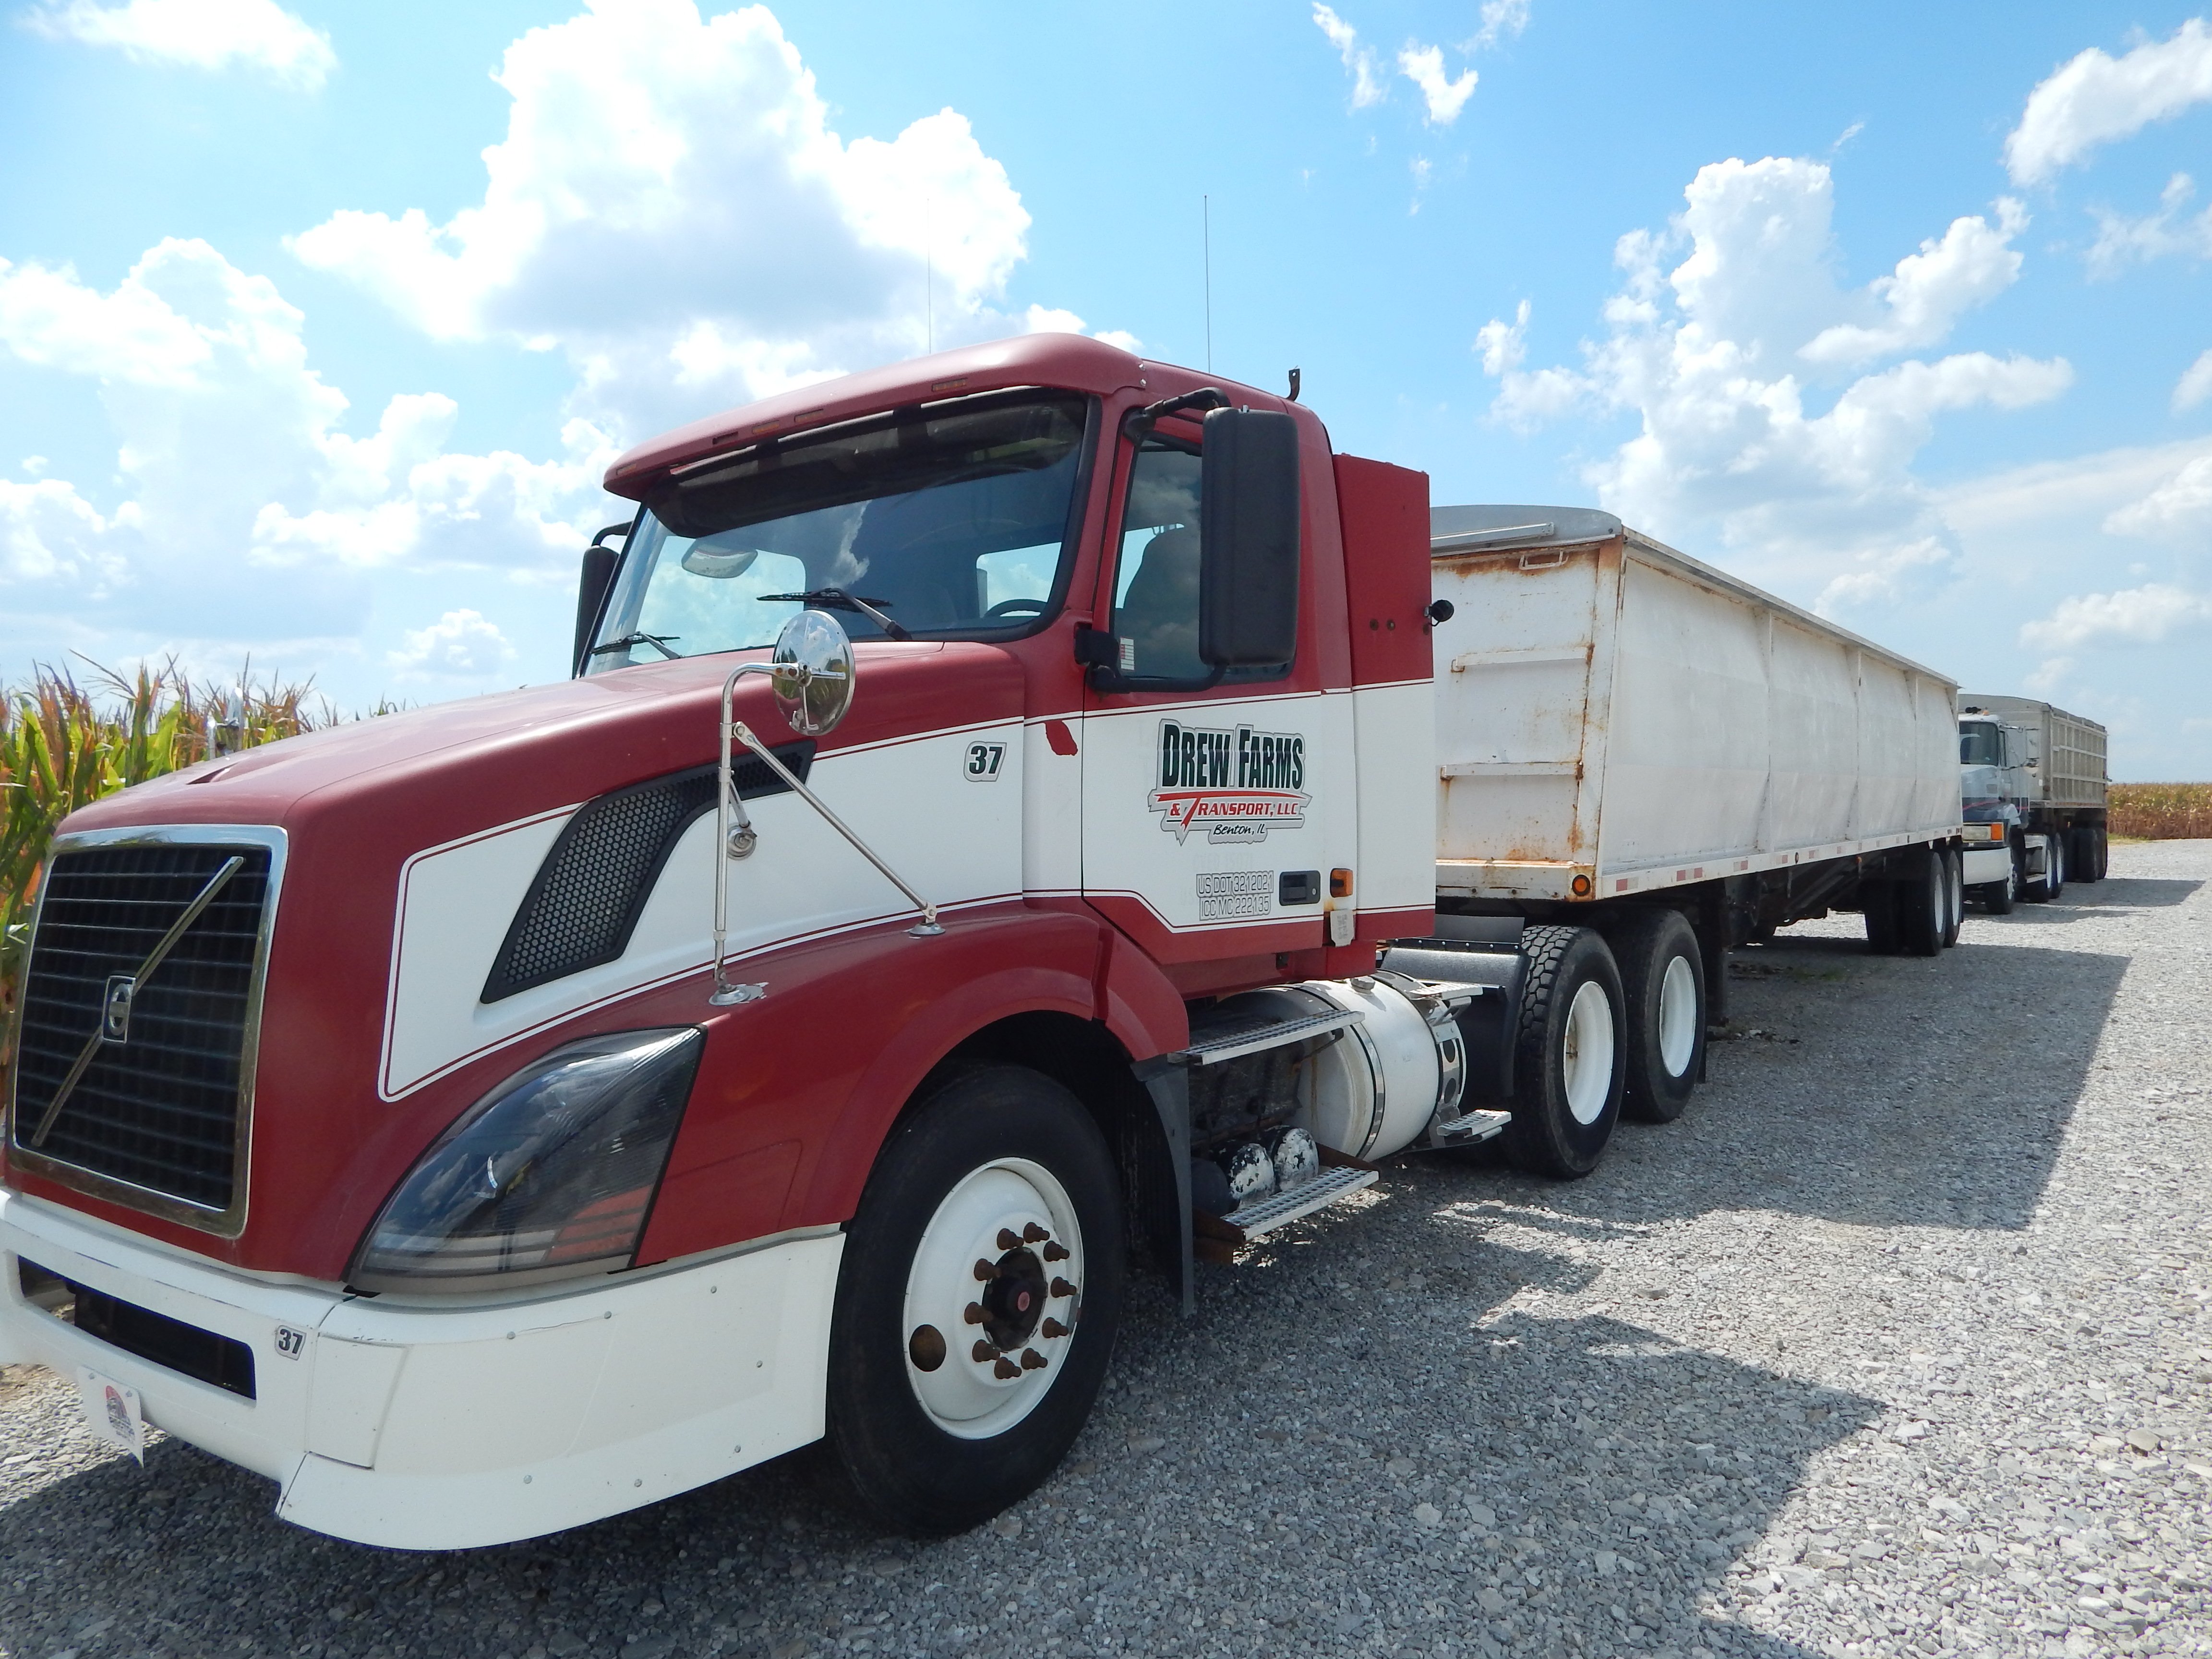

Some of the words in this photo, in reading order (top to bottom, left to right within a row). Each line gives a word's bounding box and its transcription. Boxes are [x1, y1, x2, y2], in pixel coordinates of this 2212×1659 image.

[969, 745, 1003, 774] 37
[1162, 724, 1231, 787] DREW
[1238, 729, 1303, 790] FARMS
[1170, 803, 1180, 816] &
[1276, 803, 1298, 815] LLC
[1213, 824, 1255, 836] Benton,
[1256, 823, 1266, 834] IL
[1198, 877, 1212, 894] US
[1214, 876, 1232, 893] DOT
[1233, 874, 1272, 892] 3212021
[1202, 900, 1216, 917] ICC
[1218, 898, 1233, 915] MC
[1235, 896, 1269, 914] 222135
[278, 1328, 303, 1354] 37
